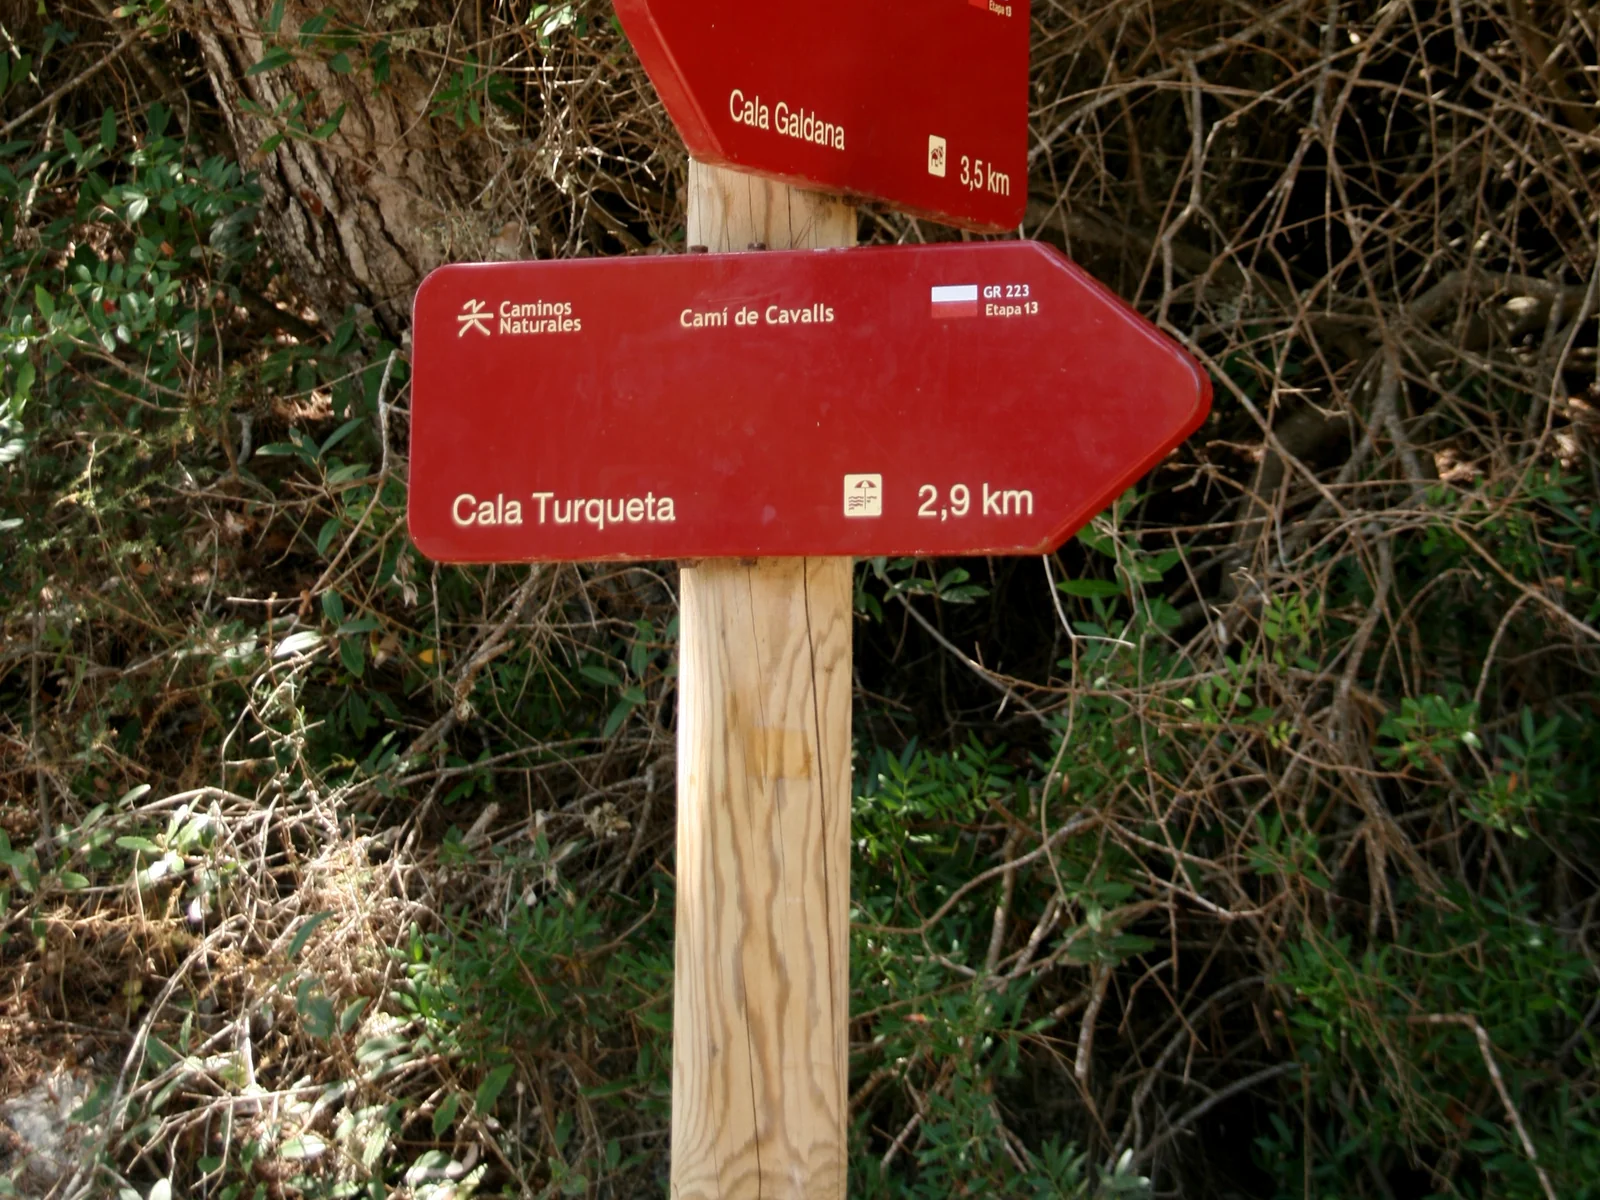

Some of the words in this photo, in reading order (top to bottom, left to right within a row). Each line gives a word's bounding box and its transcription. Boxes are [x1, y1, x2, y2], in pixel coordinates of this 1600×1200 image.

[989, 0, 1005, 16] Etapa
[1005, 5, 1012, 18] 13
[730, 89, 769, 130] Cala
[775, 102, 845, 150] Galdana
[960, 155, 983, 191] 3,5
[988, 163, 1010, 196] km
[983, 285, 1002, 298] GR
[1006, 284, 1030, 298] 223
[500, 300, 572, 317] Caminos
[680, 305, 728, 328] Camí
[734, 306, 759, 326] de
[765, 303, 834, 324] Cavalls
[985, 303, 1021, 317] Etapa
[1024, 301, 1039, 314] 13
[500, 316, 581, 334] Naturales
[452, 494, 523, 526] Cala
[532, 491, 676, 530] Turqueta
[917, 484, 971, 522] 2,9
[982, 482, 1034, 515] km
